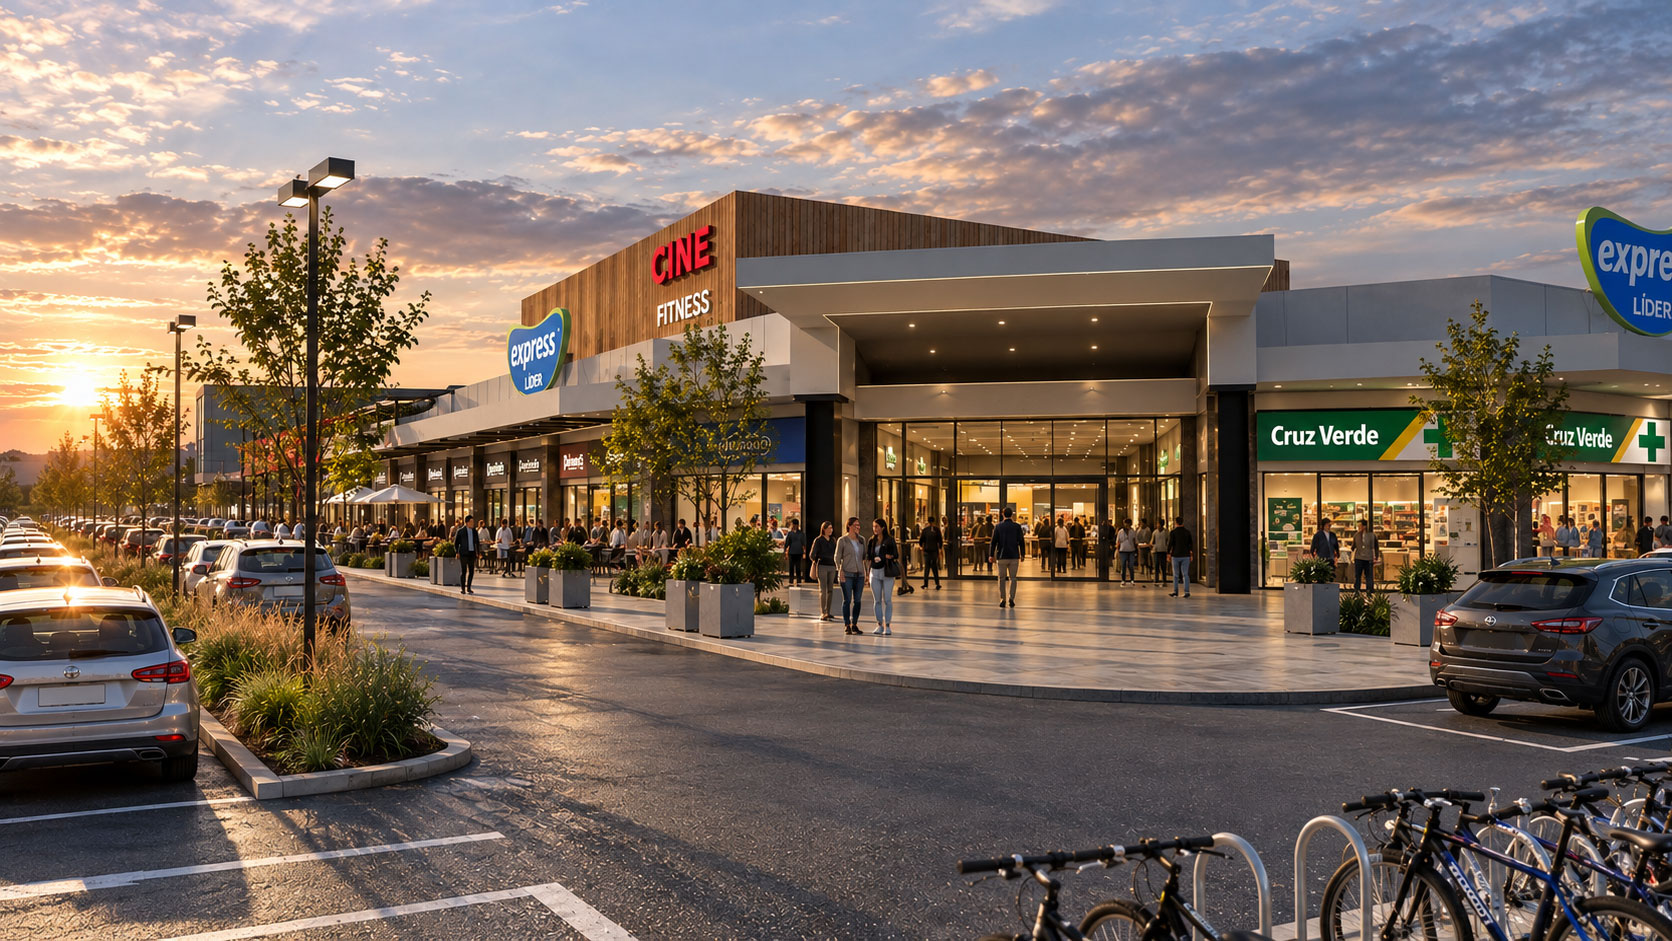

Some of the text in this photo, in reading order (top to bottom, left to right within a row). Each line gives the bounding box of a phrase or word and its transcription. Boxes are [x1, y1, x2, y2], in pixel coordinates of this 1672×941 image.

[651, 224, 712, 285] CINE
[657, 289, 710, 328] FITNESS
[1633, 292, 1672, 320] LÍDER
[510, 331, 556, 371] express
[524, 372, 543, 391] LÍDER
[1271, 424, 1379, 446] Cruz Verde
[1576, 427, 1613, 448] Verde
